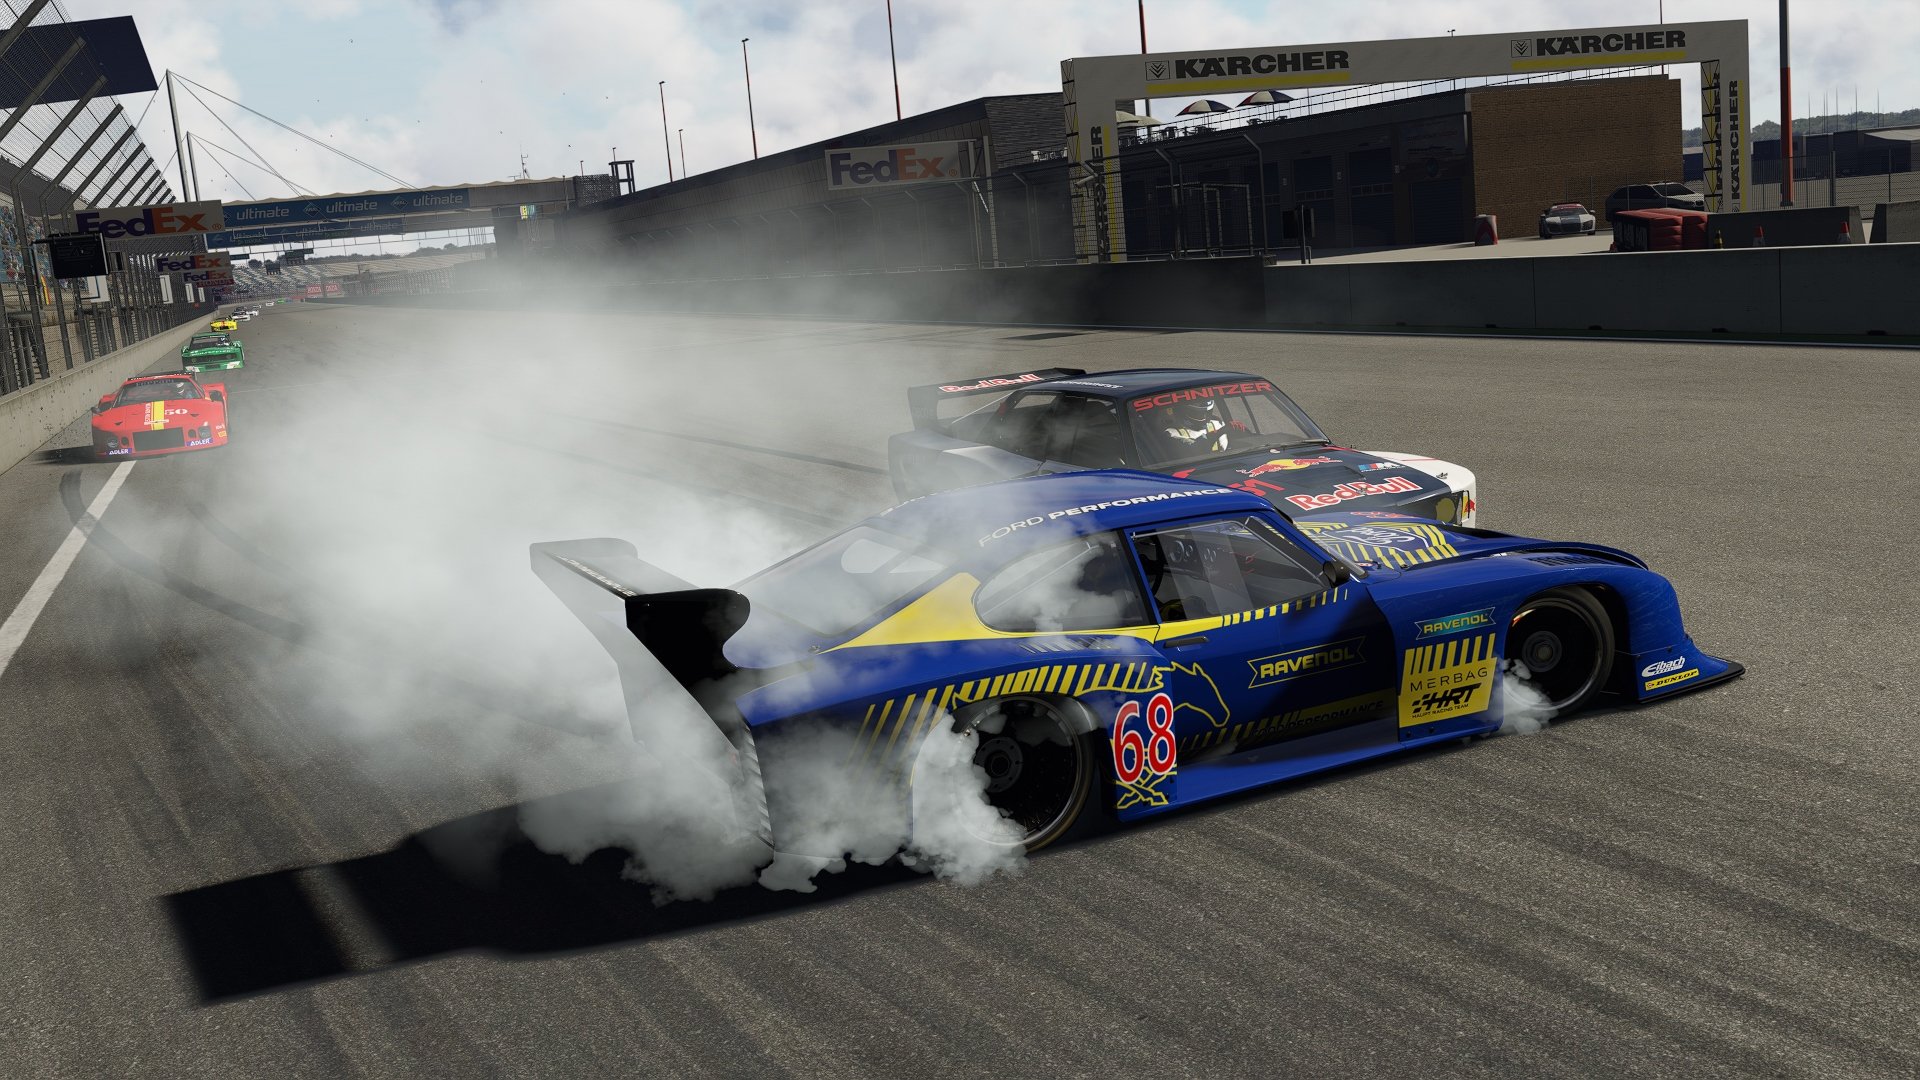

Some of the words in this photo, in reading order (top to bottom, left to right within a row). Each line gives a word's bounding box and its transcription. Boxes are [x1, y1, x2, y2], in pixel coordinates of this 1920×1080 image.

[1536, 30, 1686, 56] KÄRCHER
[1175, 50, 1350, 79] KÄRCHER
[1728, 80, 1740, 200] KÄRCHER
[829, 148, 945, 186] FedEx
[326, 200, 378, 213] ultimate
[412, 193, 463, 207] ultimate
[76, 207, 208, 238] FedEx
[236, 207, 289, 220] ultimate
[156, 255, 221, 272] FedEx
[183, 270, 226, 282] FedEx
[1132, 381, 1273, 412] SCHNITZER
[190, 438, 210, 447] ADLER
[978, 516, 1044, 547] FORD
[1048, 488, 1234, 520] PERFORMANCE
[1424, 614, 1488, 634] RAVENOL
[1260, 647, 1356, 679] RAVENOL
[1641, 656, 1686, 677] Eibach
[1410, 667, 1488, 692] MERBAG
[1656, 670, 1698, 686] DUNLOP
[1417, 683, 1482, 711] HRT
[1432, 706, 1454, 714] RACING
[1113, 692, 1177, 785] 68
